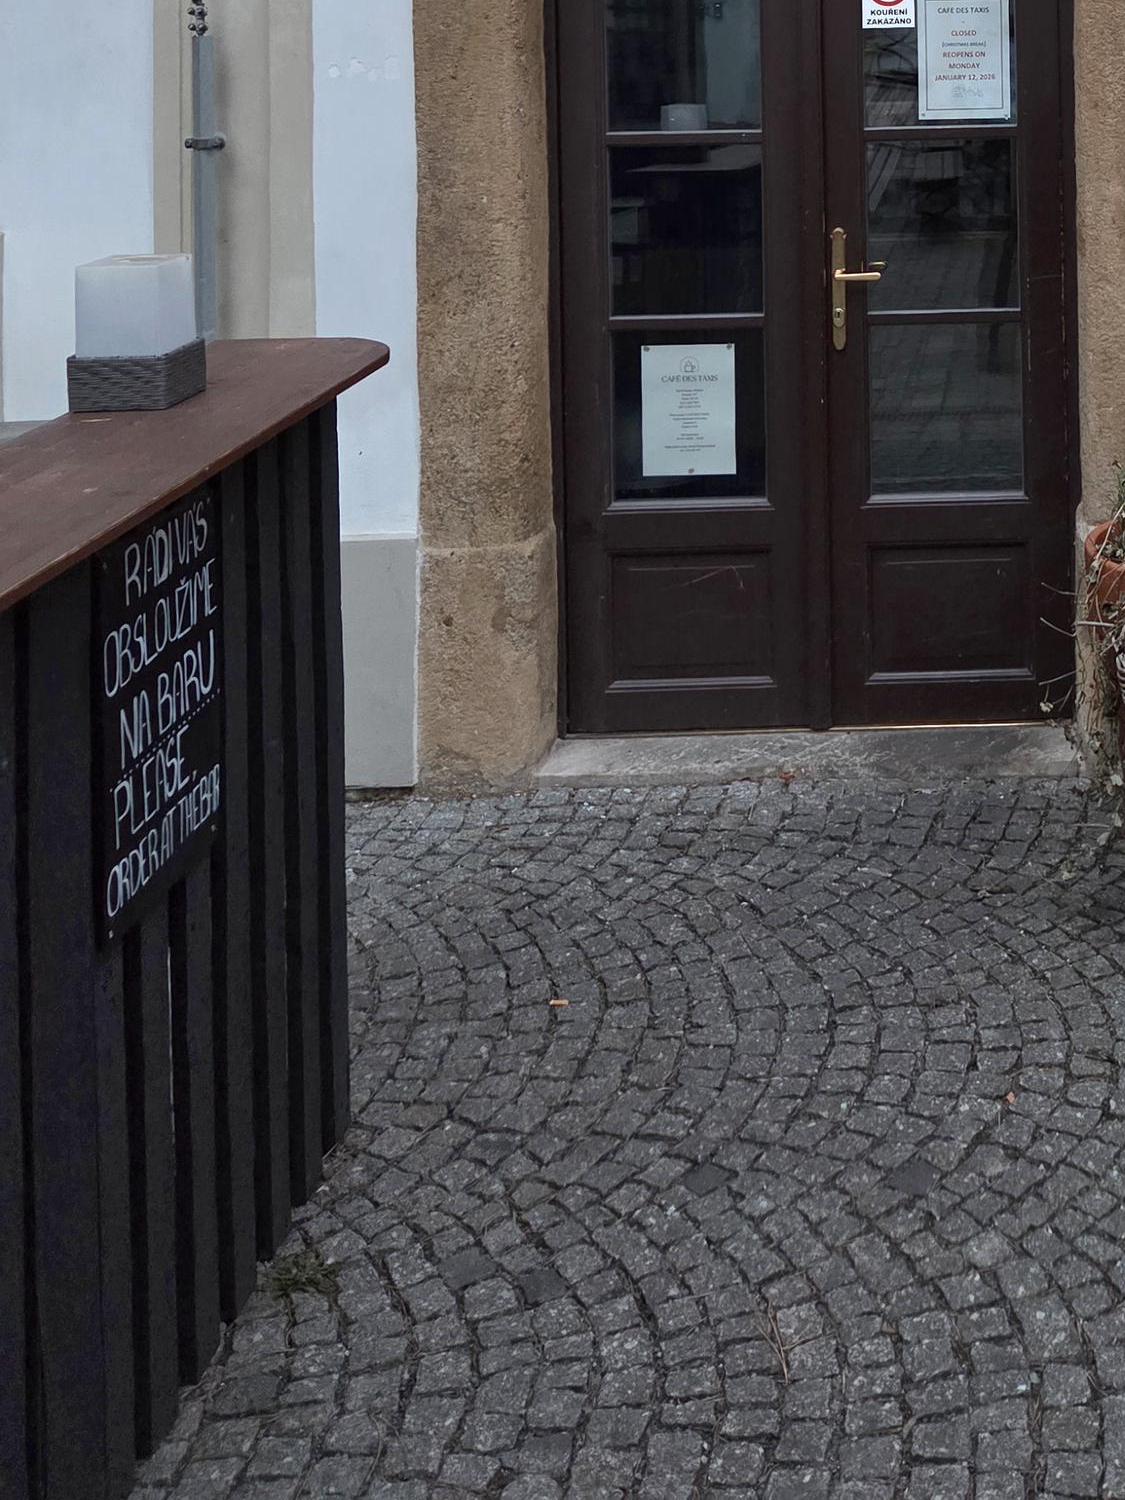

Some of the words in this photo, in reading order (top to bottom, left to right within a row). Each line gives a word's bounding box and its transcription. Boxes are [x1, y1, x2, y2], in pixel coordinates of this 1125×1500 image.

[870, 7, 908, 16] KOUŘENÍ
[970, 6, 990, 14] TAXIS
[866, 17, 912, 25] ZAKÁZÁNO
[951, 29, 977, 37] CLOSED
[975, 50, 986, 58] ON
[682, 374, 697, 382] DES
[125, 522, 173, 607] RÁDI
[175, 501, 208, 565] VÁS
[119, 688, 152, 770] NA
[157, 629, 215, 738] BARU
[106, 828, 160, 918] ORDER
[160, 805, 177, 866] AT
[178, 786, 203, 843] THE
[199, 764, 220, 825] BAR
